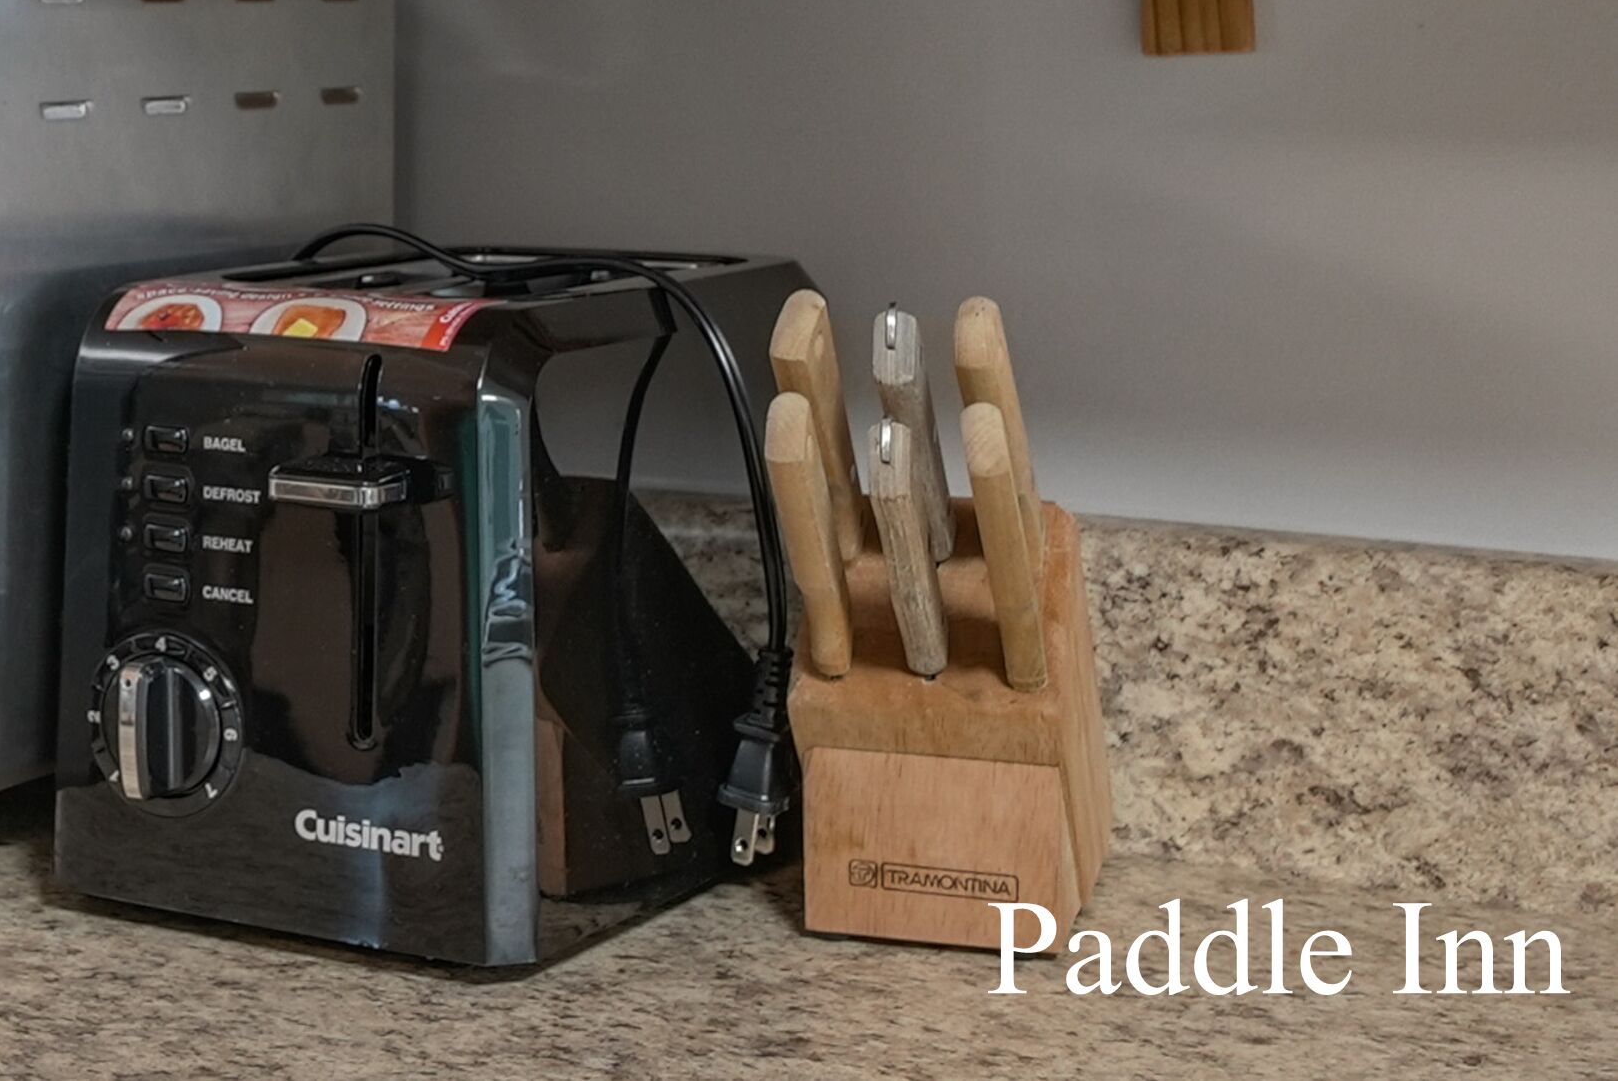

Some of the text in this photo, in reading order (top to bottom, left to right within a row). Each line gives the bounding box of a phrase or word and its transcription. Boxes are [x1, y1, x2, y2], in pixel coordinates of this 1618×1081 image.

[203, 436, 246, 453] BAGEL
[202, 486, 261, 504] DEFROST
[202, 535, 253, 553] REHEAT
[202, 585, 254, 604] CANCEL
[155, 636, 167, 652] 4
[106, 655, 120, 670] 3
[203, 666, 217, 681] 5
[87, 710, 101, 723] 2
[223, 728, 238, 741] 6
[205, 783, 218, 799] 7
[295, 808, 443, 861] Cuisinart
[885, 869, 1012, 896] TRAMONTINA
